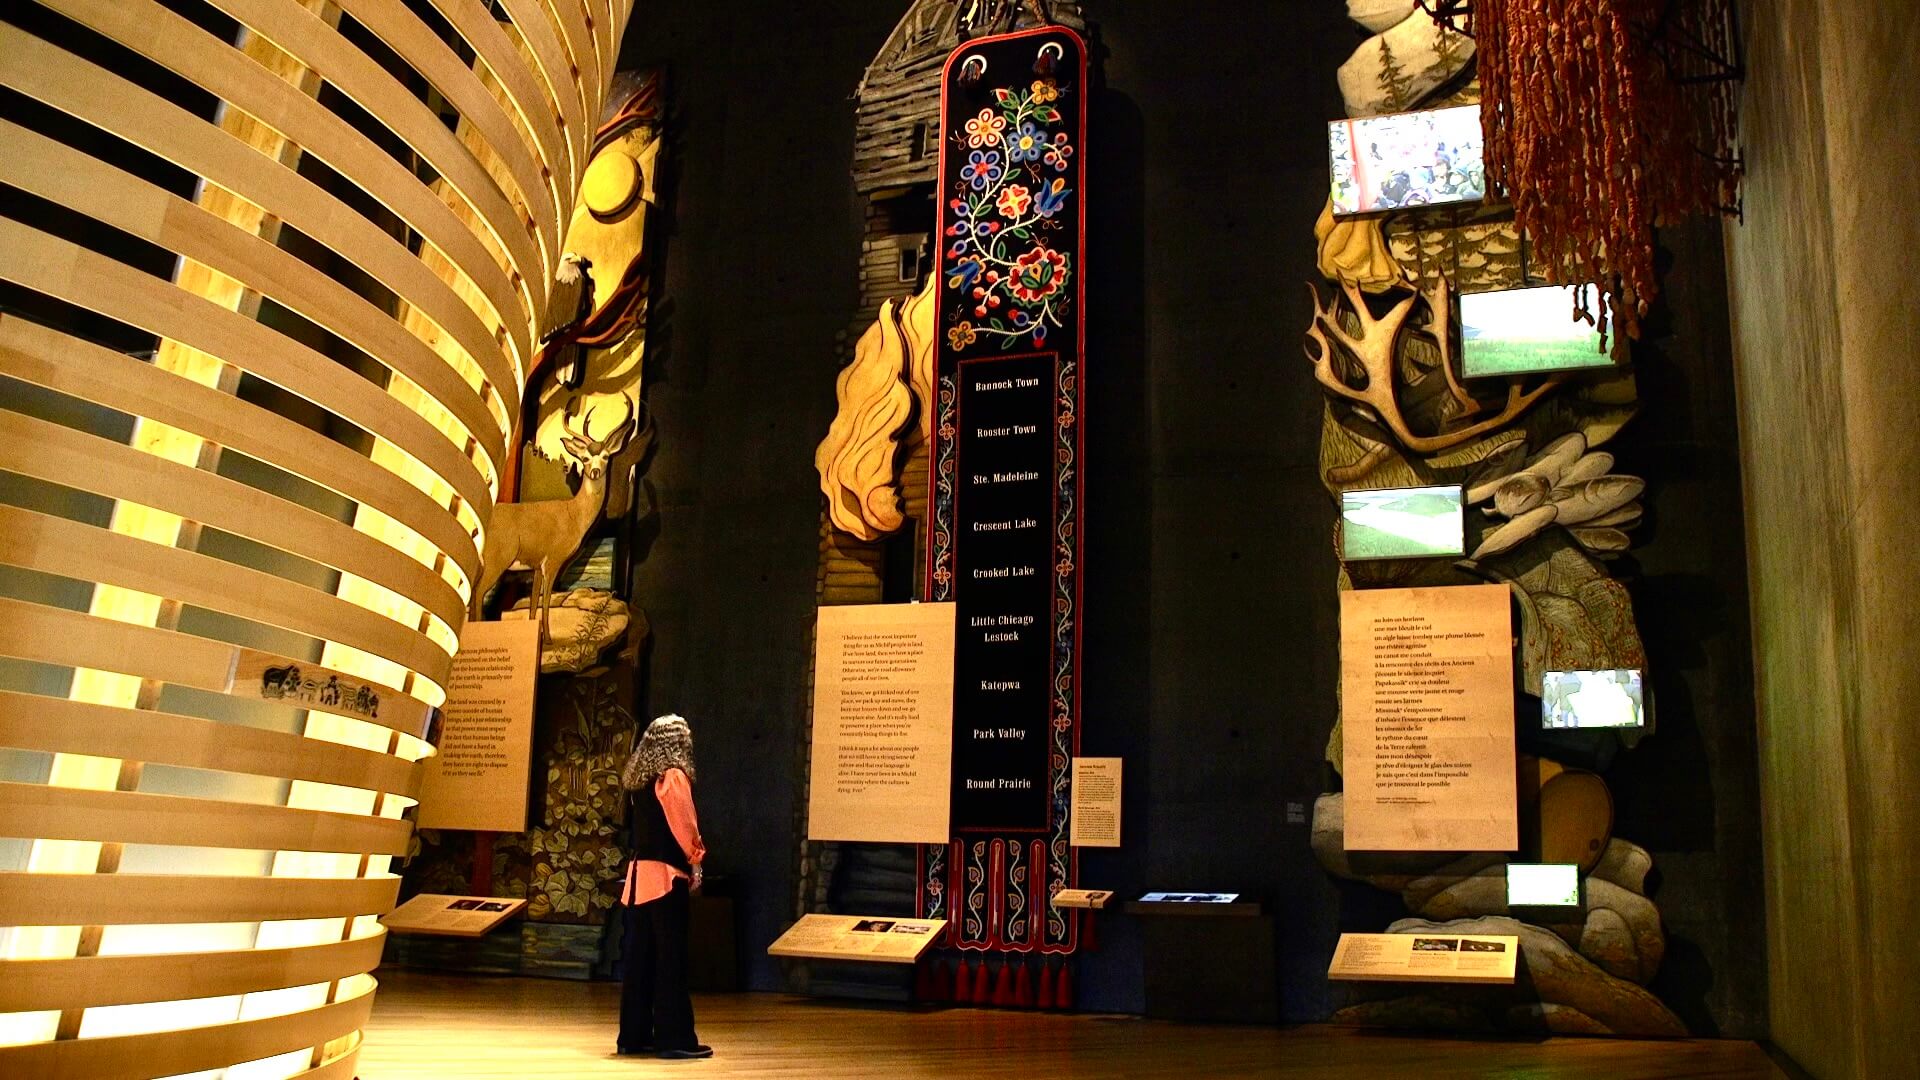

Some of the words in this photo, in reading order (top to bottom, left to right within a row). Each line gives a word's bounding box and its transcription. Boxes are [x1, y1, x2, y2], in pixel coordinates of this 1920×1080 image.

[976, 379, 1013, 392] Bannock
[1016, 378, 1039, 388] Town
[977, 428, 1010, 438] Rooster
[1013, 425, 1036, 435] Town
[973, 474, 990, 484] Ste.
[993, 471, 1039, 483] Madeleine
[974, 520, 1012, 532] Crescent
[1015, 518, 1037, 529] Lake
[974, 567, 1009, 578] Crooked
[1012, 566, 1034, 577] Lake
[971, 616, 996, 626] Little
[998, 614, 1034, 626] Chicago
[984, 632, 1019, 642] Lestock
[981, 680, 1020, 692] Katepwa
[974, 728, 994, 740] Park
[998, 728, 1026, 740] Valley
[966, 778, 995, 789] Round
[1000, 778, 1031, 789] Prairie
